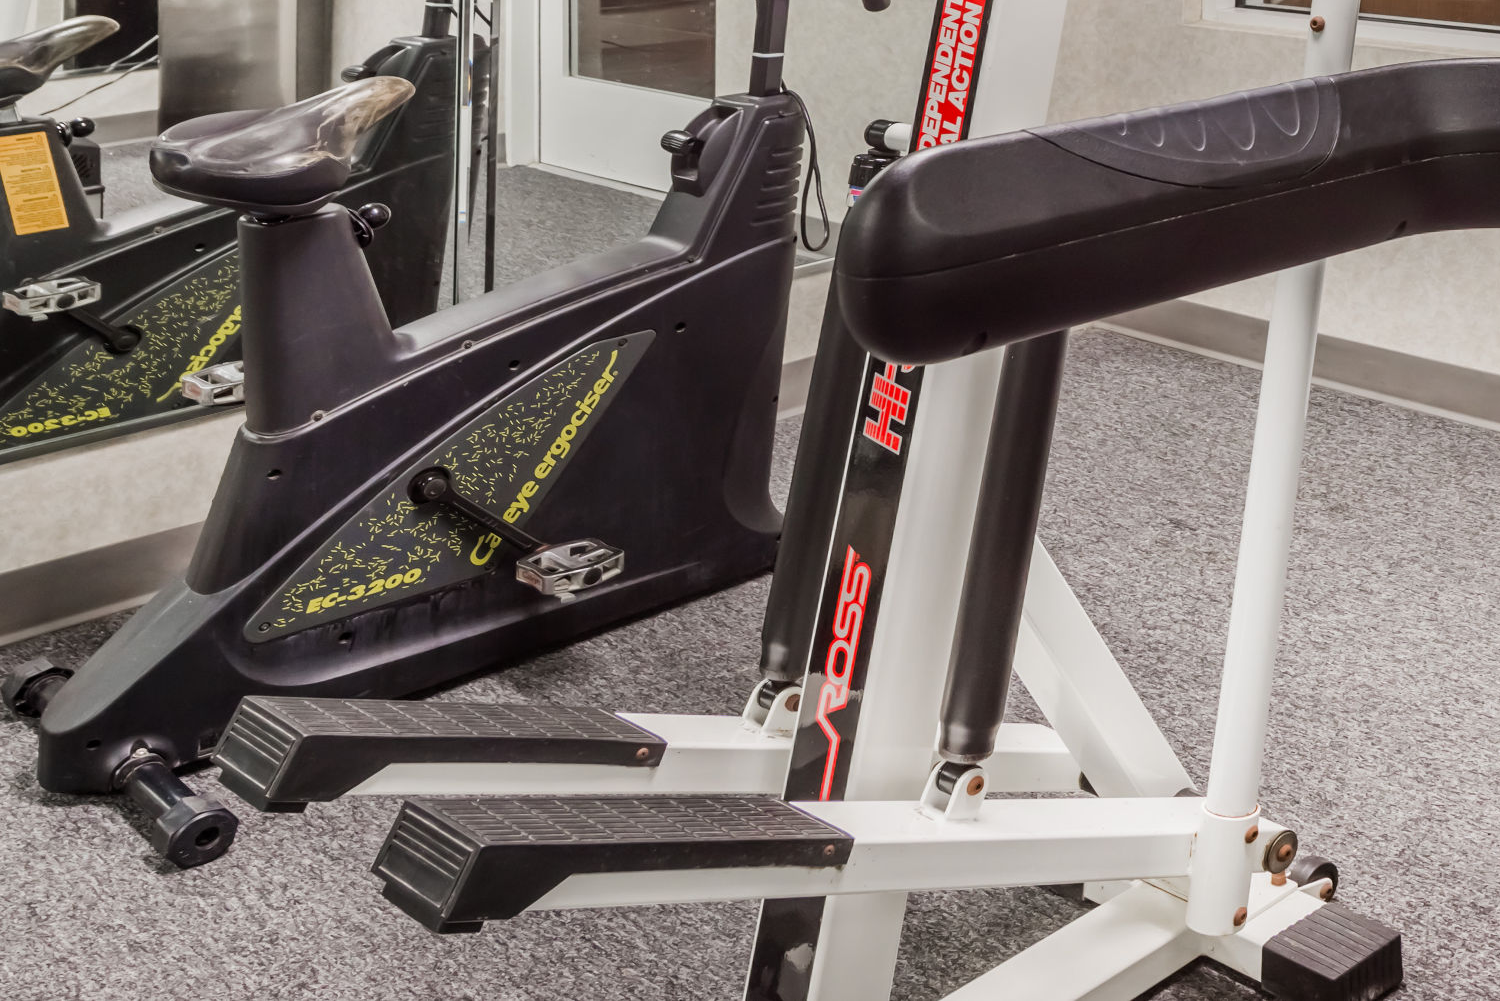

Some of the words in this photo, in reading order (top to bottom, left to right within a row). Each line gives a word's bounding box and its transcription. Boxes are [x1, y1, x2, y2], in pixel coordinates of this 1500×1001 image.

[947, 0, 983, 112] ACTION
[939, 116, 963, 146] AL
[534, 349, 618, 480] ergociser
[306, 568, 422, 614] EC-3200
[815, 544, 872, 737] ROSS
